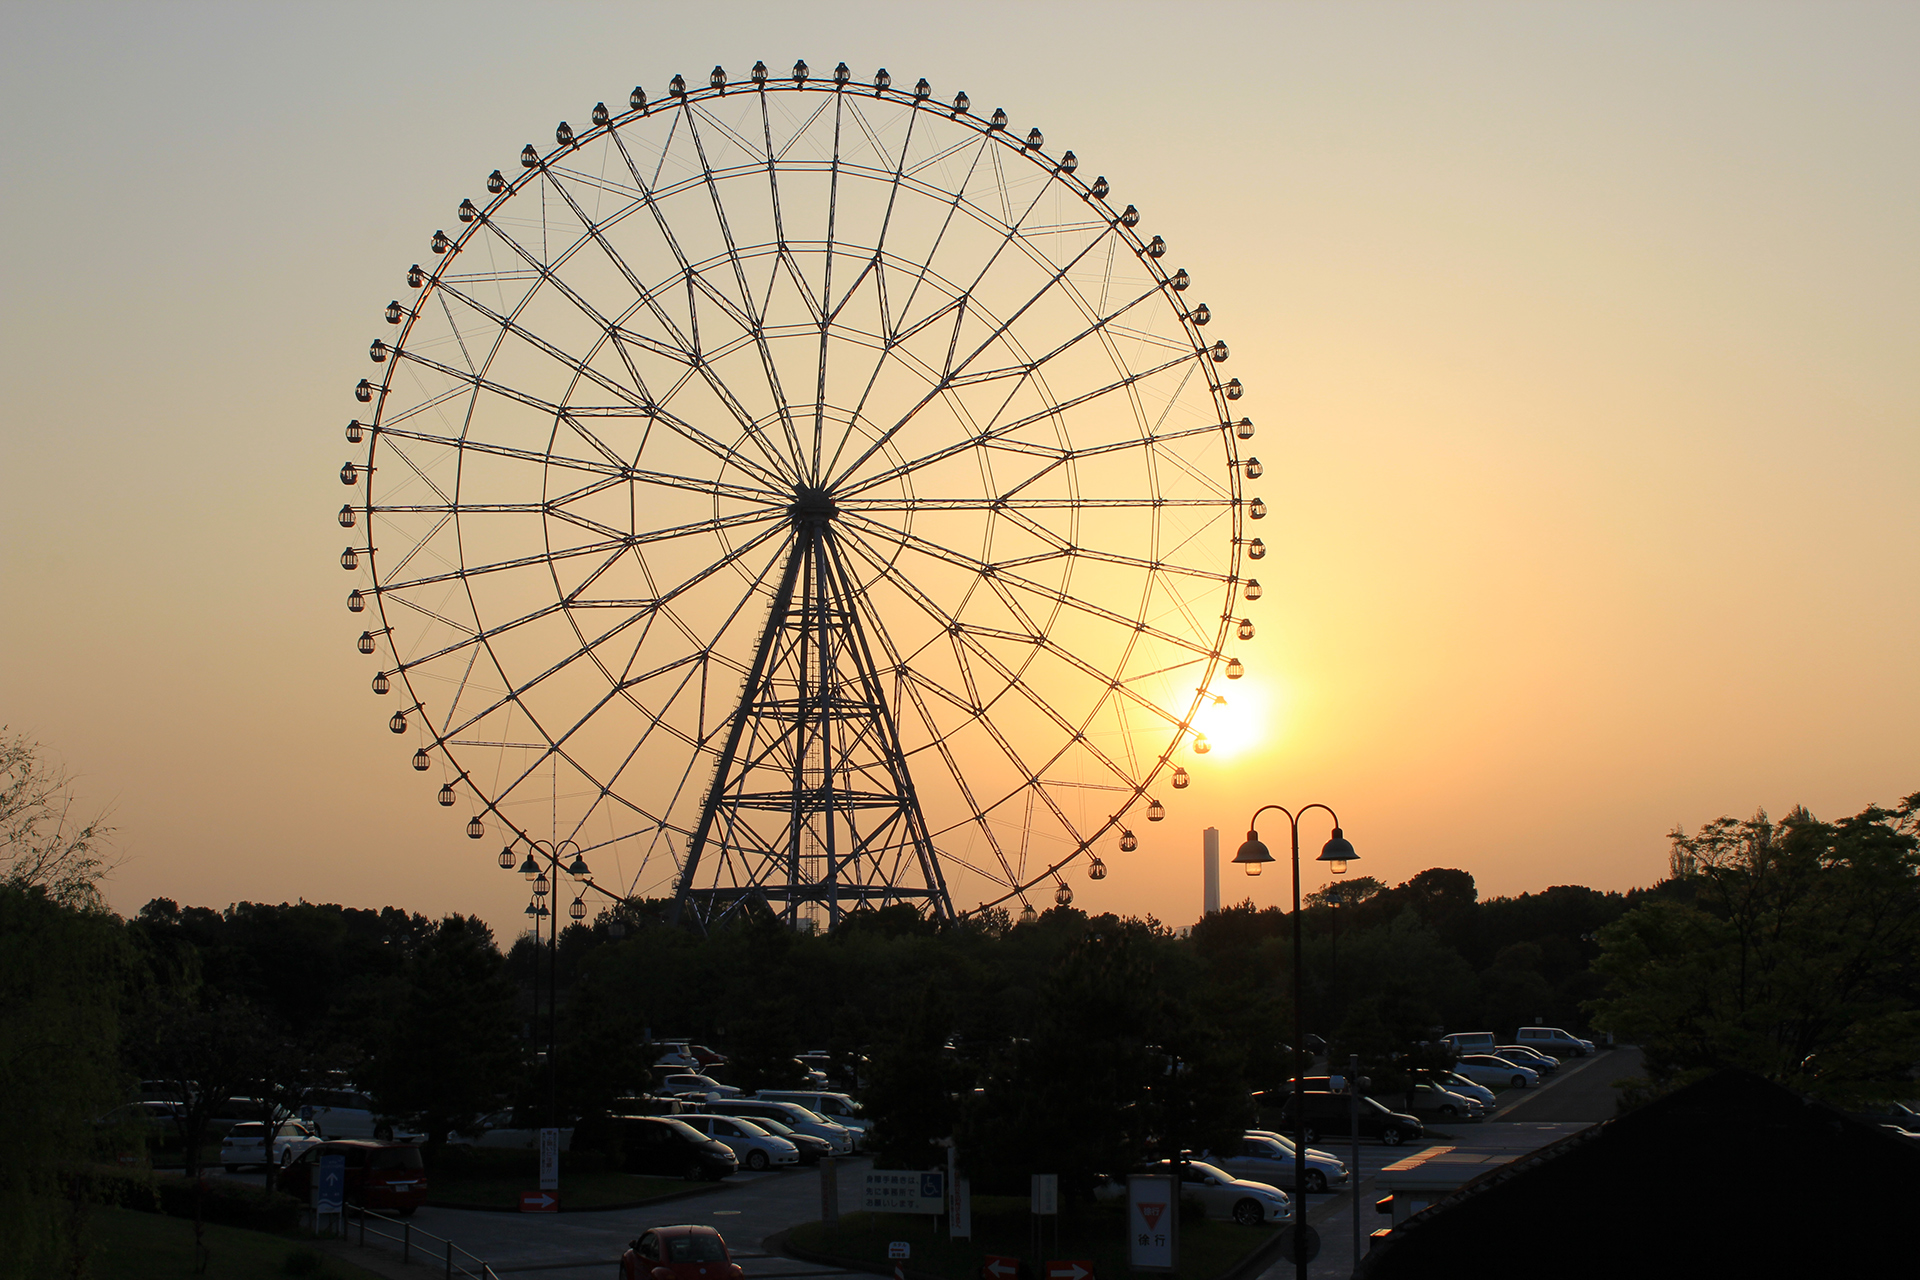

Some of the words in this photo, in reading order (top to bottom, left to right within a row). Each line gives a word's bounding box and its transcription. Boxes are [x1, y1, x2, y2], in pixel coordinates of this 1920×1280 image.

[866, 1175, 919, 1185] 身障手続きは、
[865, 1187, 915, 1197] 先に事務所で
[865, 1199, 919, 1209] お願いします。
[1143, 1207, 1160, 1216] 徐行
[1138, 1233, 1166, 1247] 徐行
